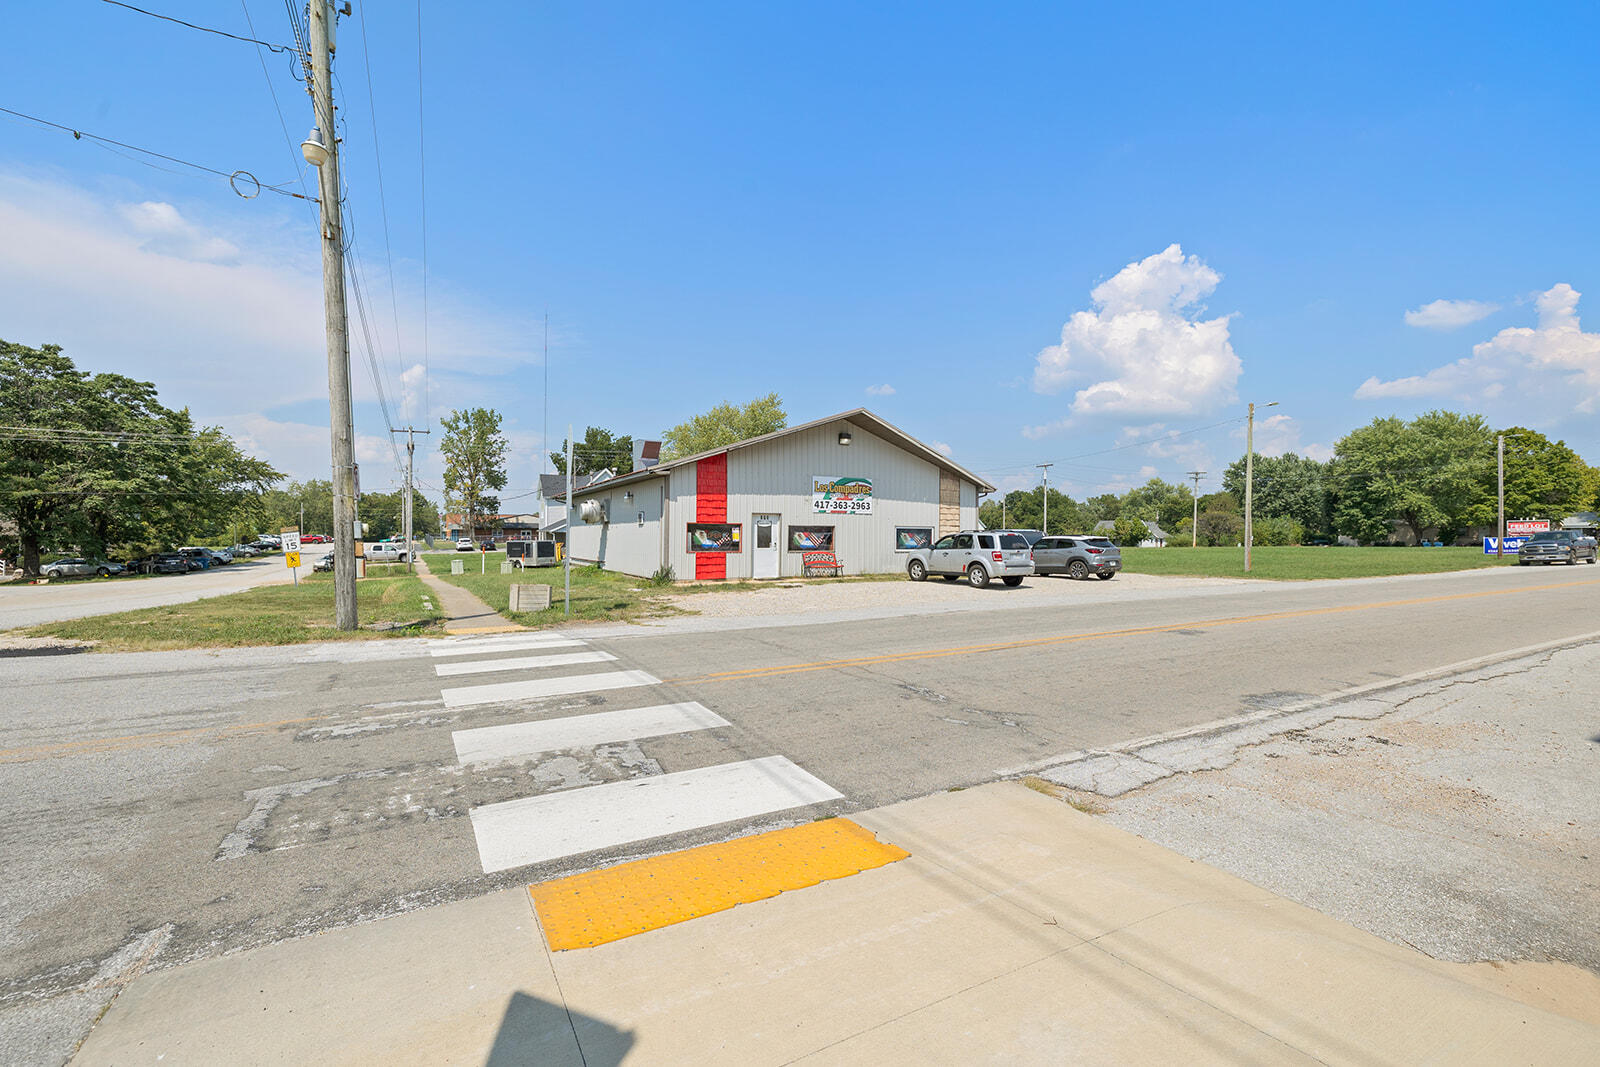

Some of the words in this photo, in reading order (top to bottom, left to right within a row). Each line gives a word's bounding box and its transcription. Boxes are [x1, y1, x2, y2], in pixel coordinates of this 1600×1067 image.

[814, 480, 828, 493] Los
[829, 481, 870, 496] Compadres
[814, 500, 871, 510] 417-363-2963
[286, 542, 298, 550] 15
[1488, 538, 1524, 549] Vvek
